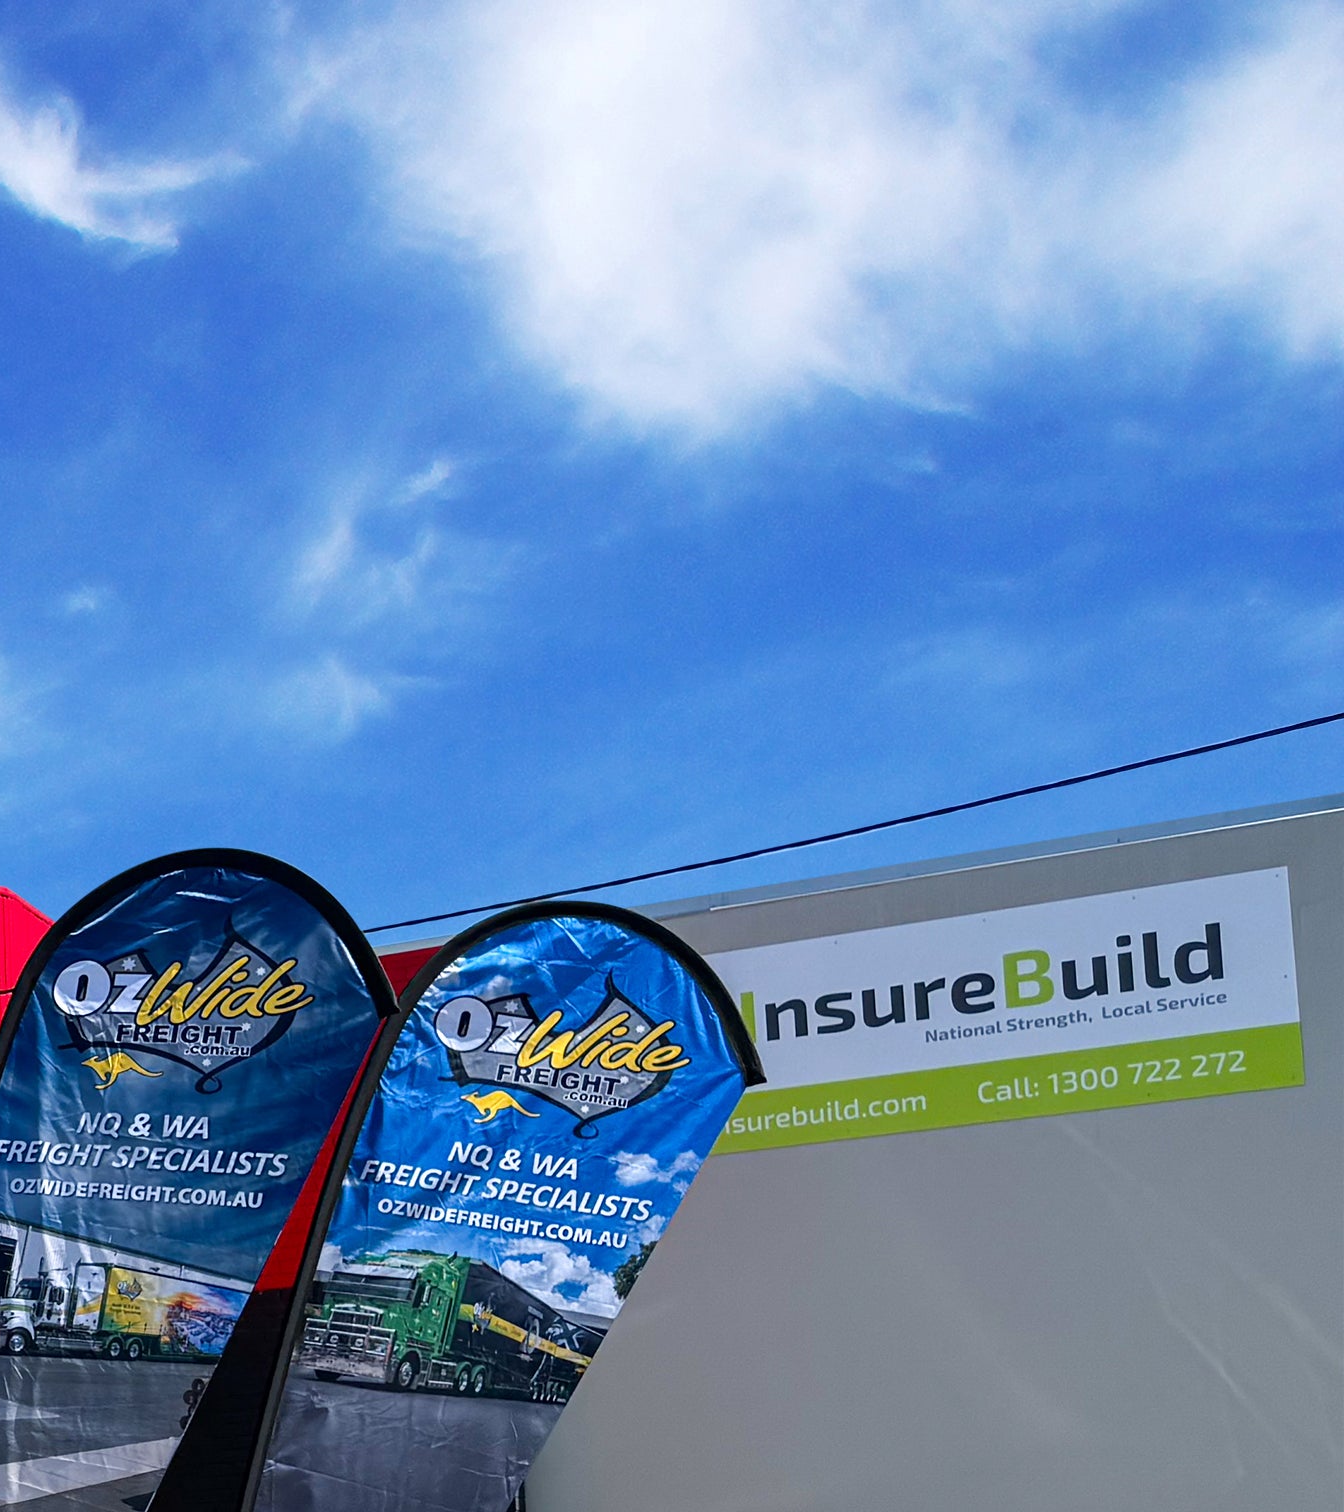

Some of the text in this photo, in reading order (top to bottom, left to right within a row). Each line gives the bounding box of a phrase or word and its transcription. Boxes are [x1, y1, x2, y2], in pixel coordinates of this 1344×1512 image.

[740, 922, 1224, 1044] InsureBuild
[925, 990, 1227, 1043] National Strength, Local Service
[116, 1022, 243, 1046] FREIGHT
[184, 1041, 251, 1057] .com.au
[496, 1064, 623, 1097] FREIGHT
[977, 1049, 1247, 1105] Call: 1300 722 272
[564, 1090, 629, 1109] .com.au
[77, 1111, 210, 1140] NQ & WA
[112, 1144, 288, 1178] SPECIALISTS
[448, 1141, 580, 1180] NQ & WA
[10, 1176, 264, 1208] OZWIDEFREIGHT.COM.AU
[360, 1159, 654, 1223] FREIGHT SPECIALISTS
[377, 1198, 629, 1250] OZWIDEFREIGHT.COM.AU
